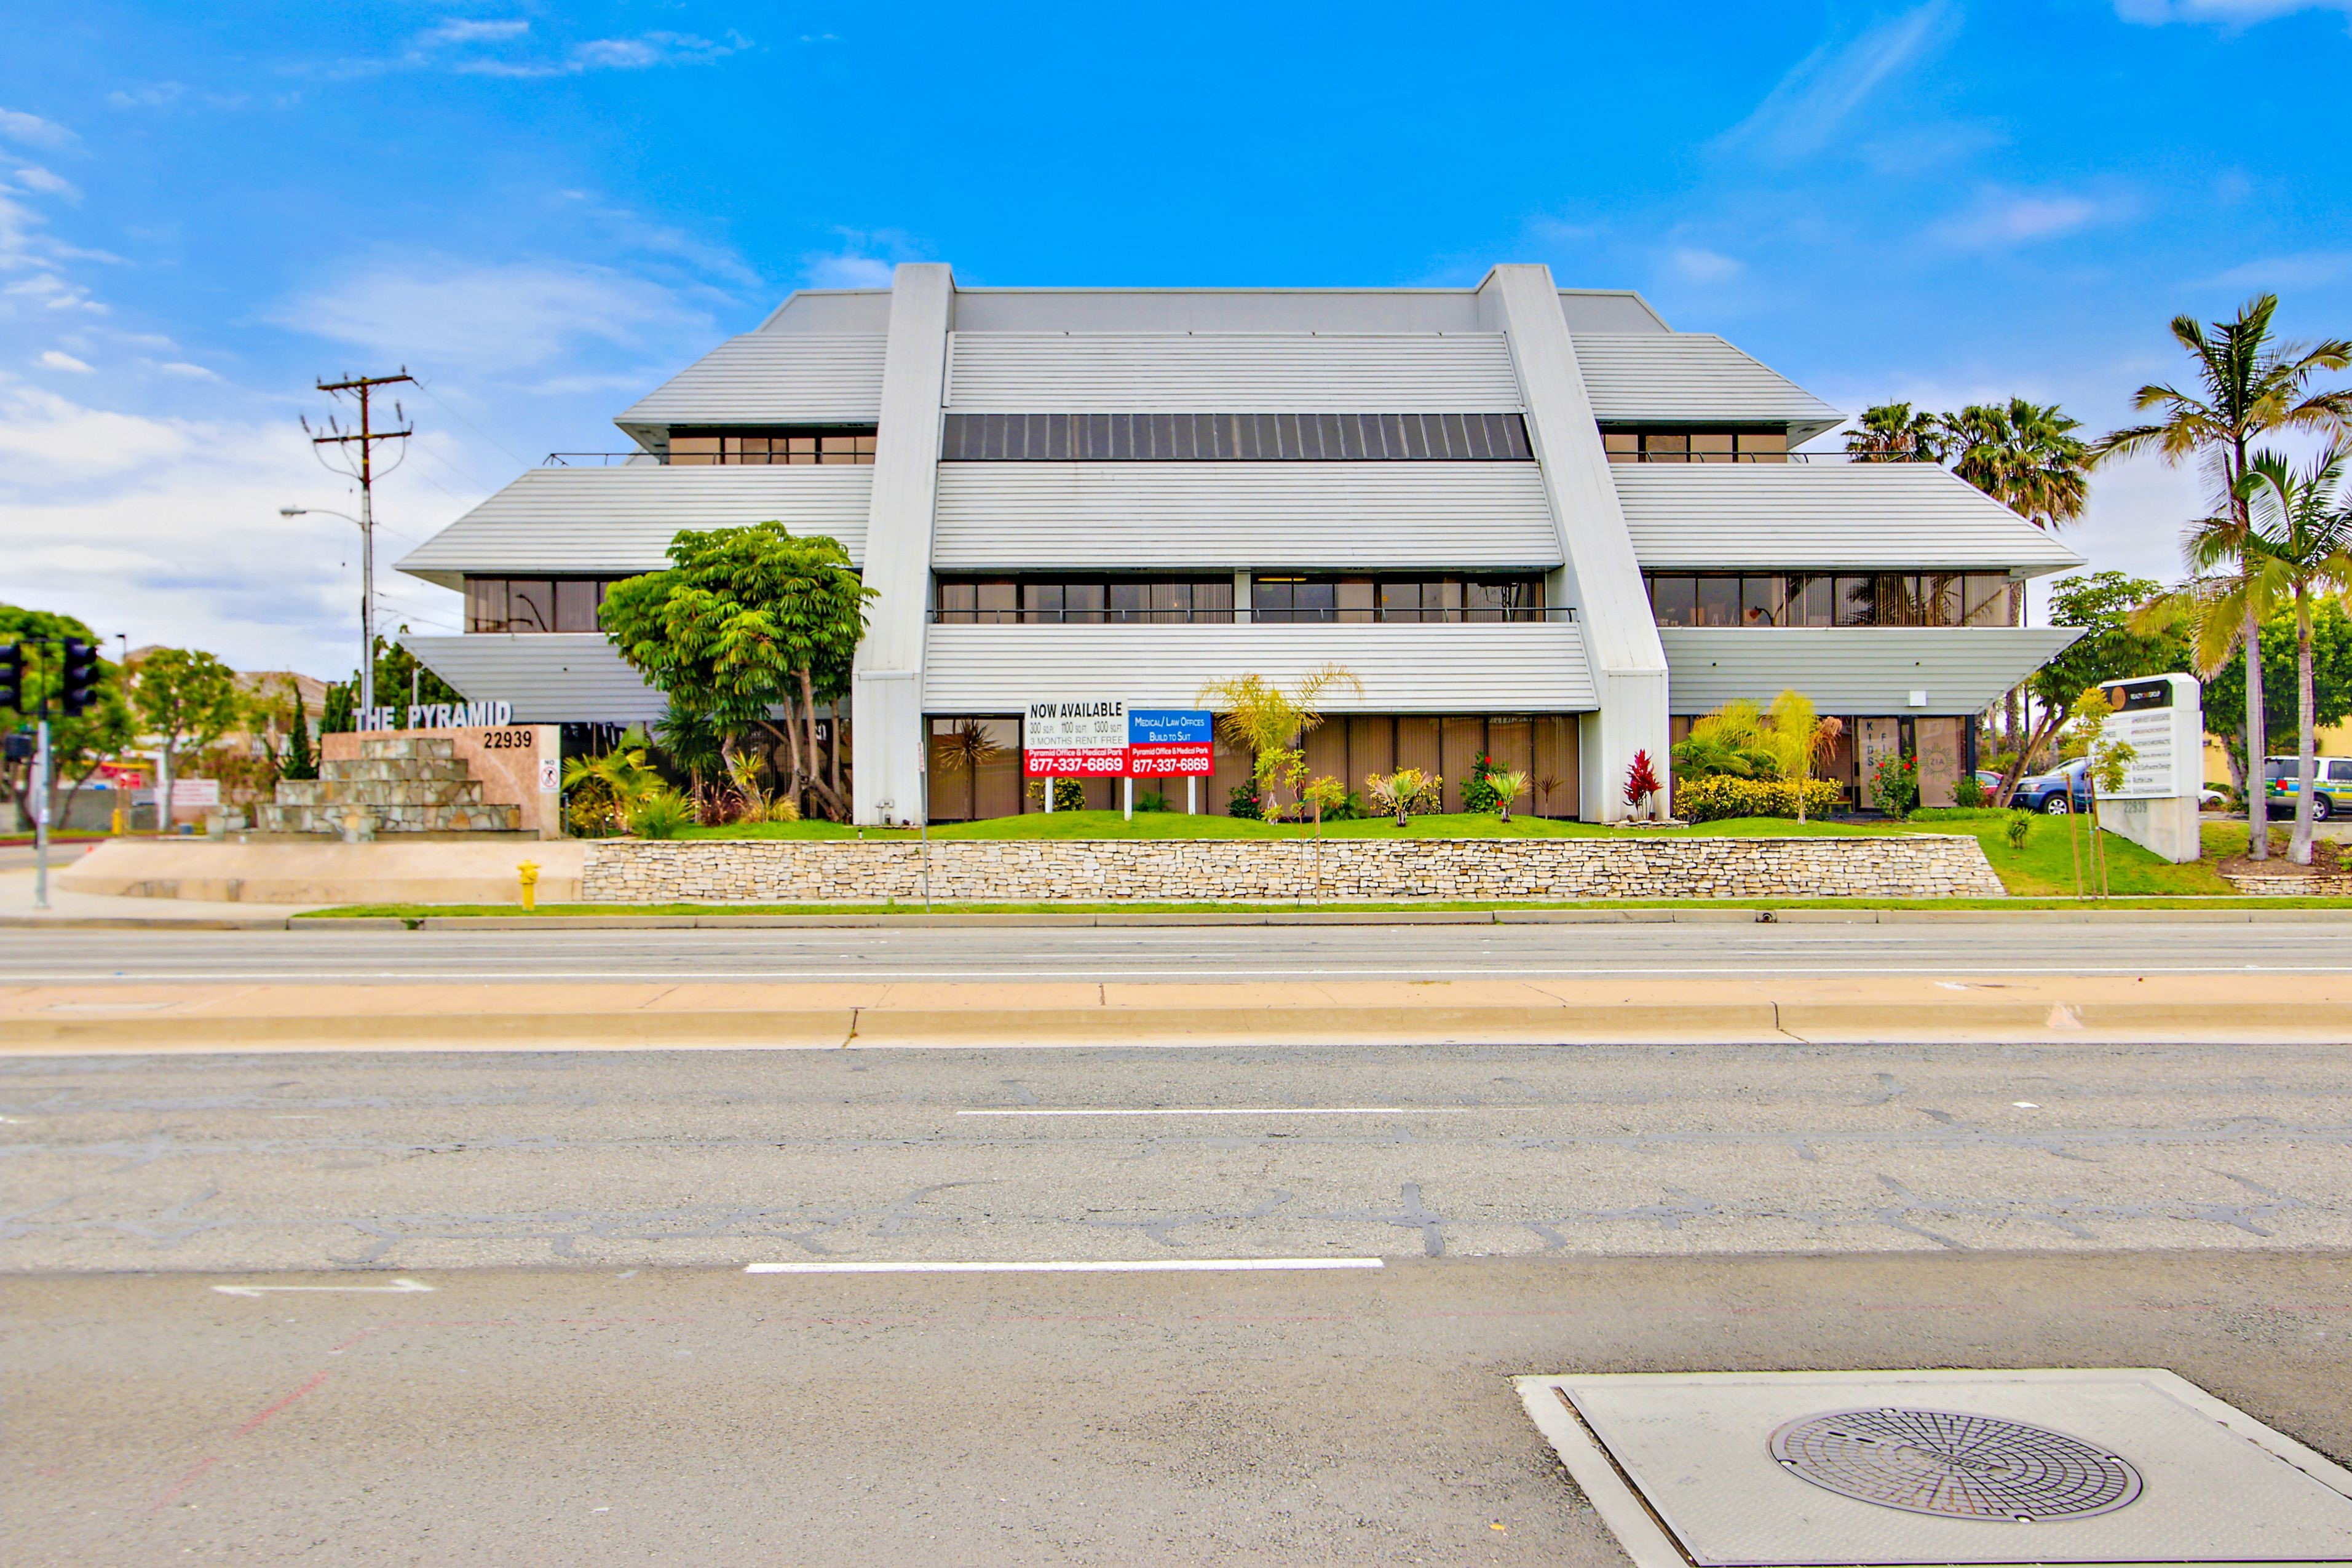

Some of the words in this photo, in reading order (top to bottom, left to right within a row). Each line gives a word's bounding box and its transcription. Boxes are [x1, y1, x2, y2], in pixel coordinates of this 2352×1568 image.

[352, 706, 395, 732] THE
[408, 700, 512, 730] PYRAMID
[1031, 704, 1056, 718] NOW
[1061, 702, 1122, 718] AVAILABLE
[1030, 723, 1041, 734] 300
[1094, 721, 1107, 732] 1300
[485, 731, 532, 749] 22939
[1133, 748, 1155, 757] Pyramid
[1029, 758, 1123, 772] 877-337-6869
[1133, 757, 1208, 773] 877-337-6869
[1930, 758, 1945, 766] ZIA
[2124, 801, 2147, 814] 22939
